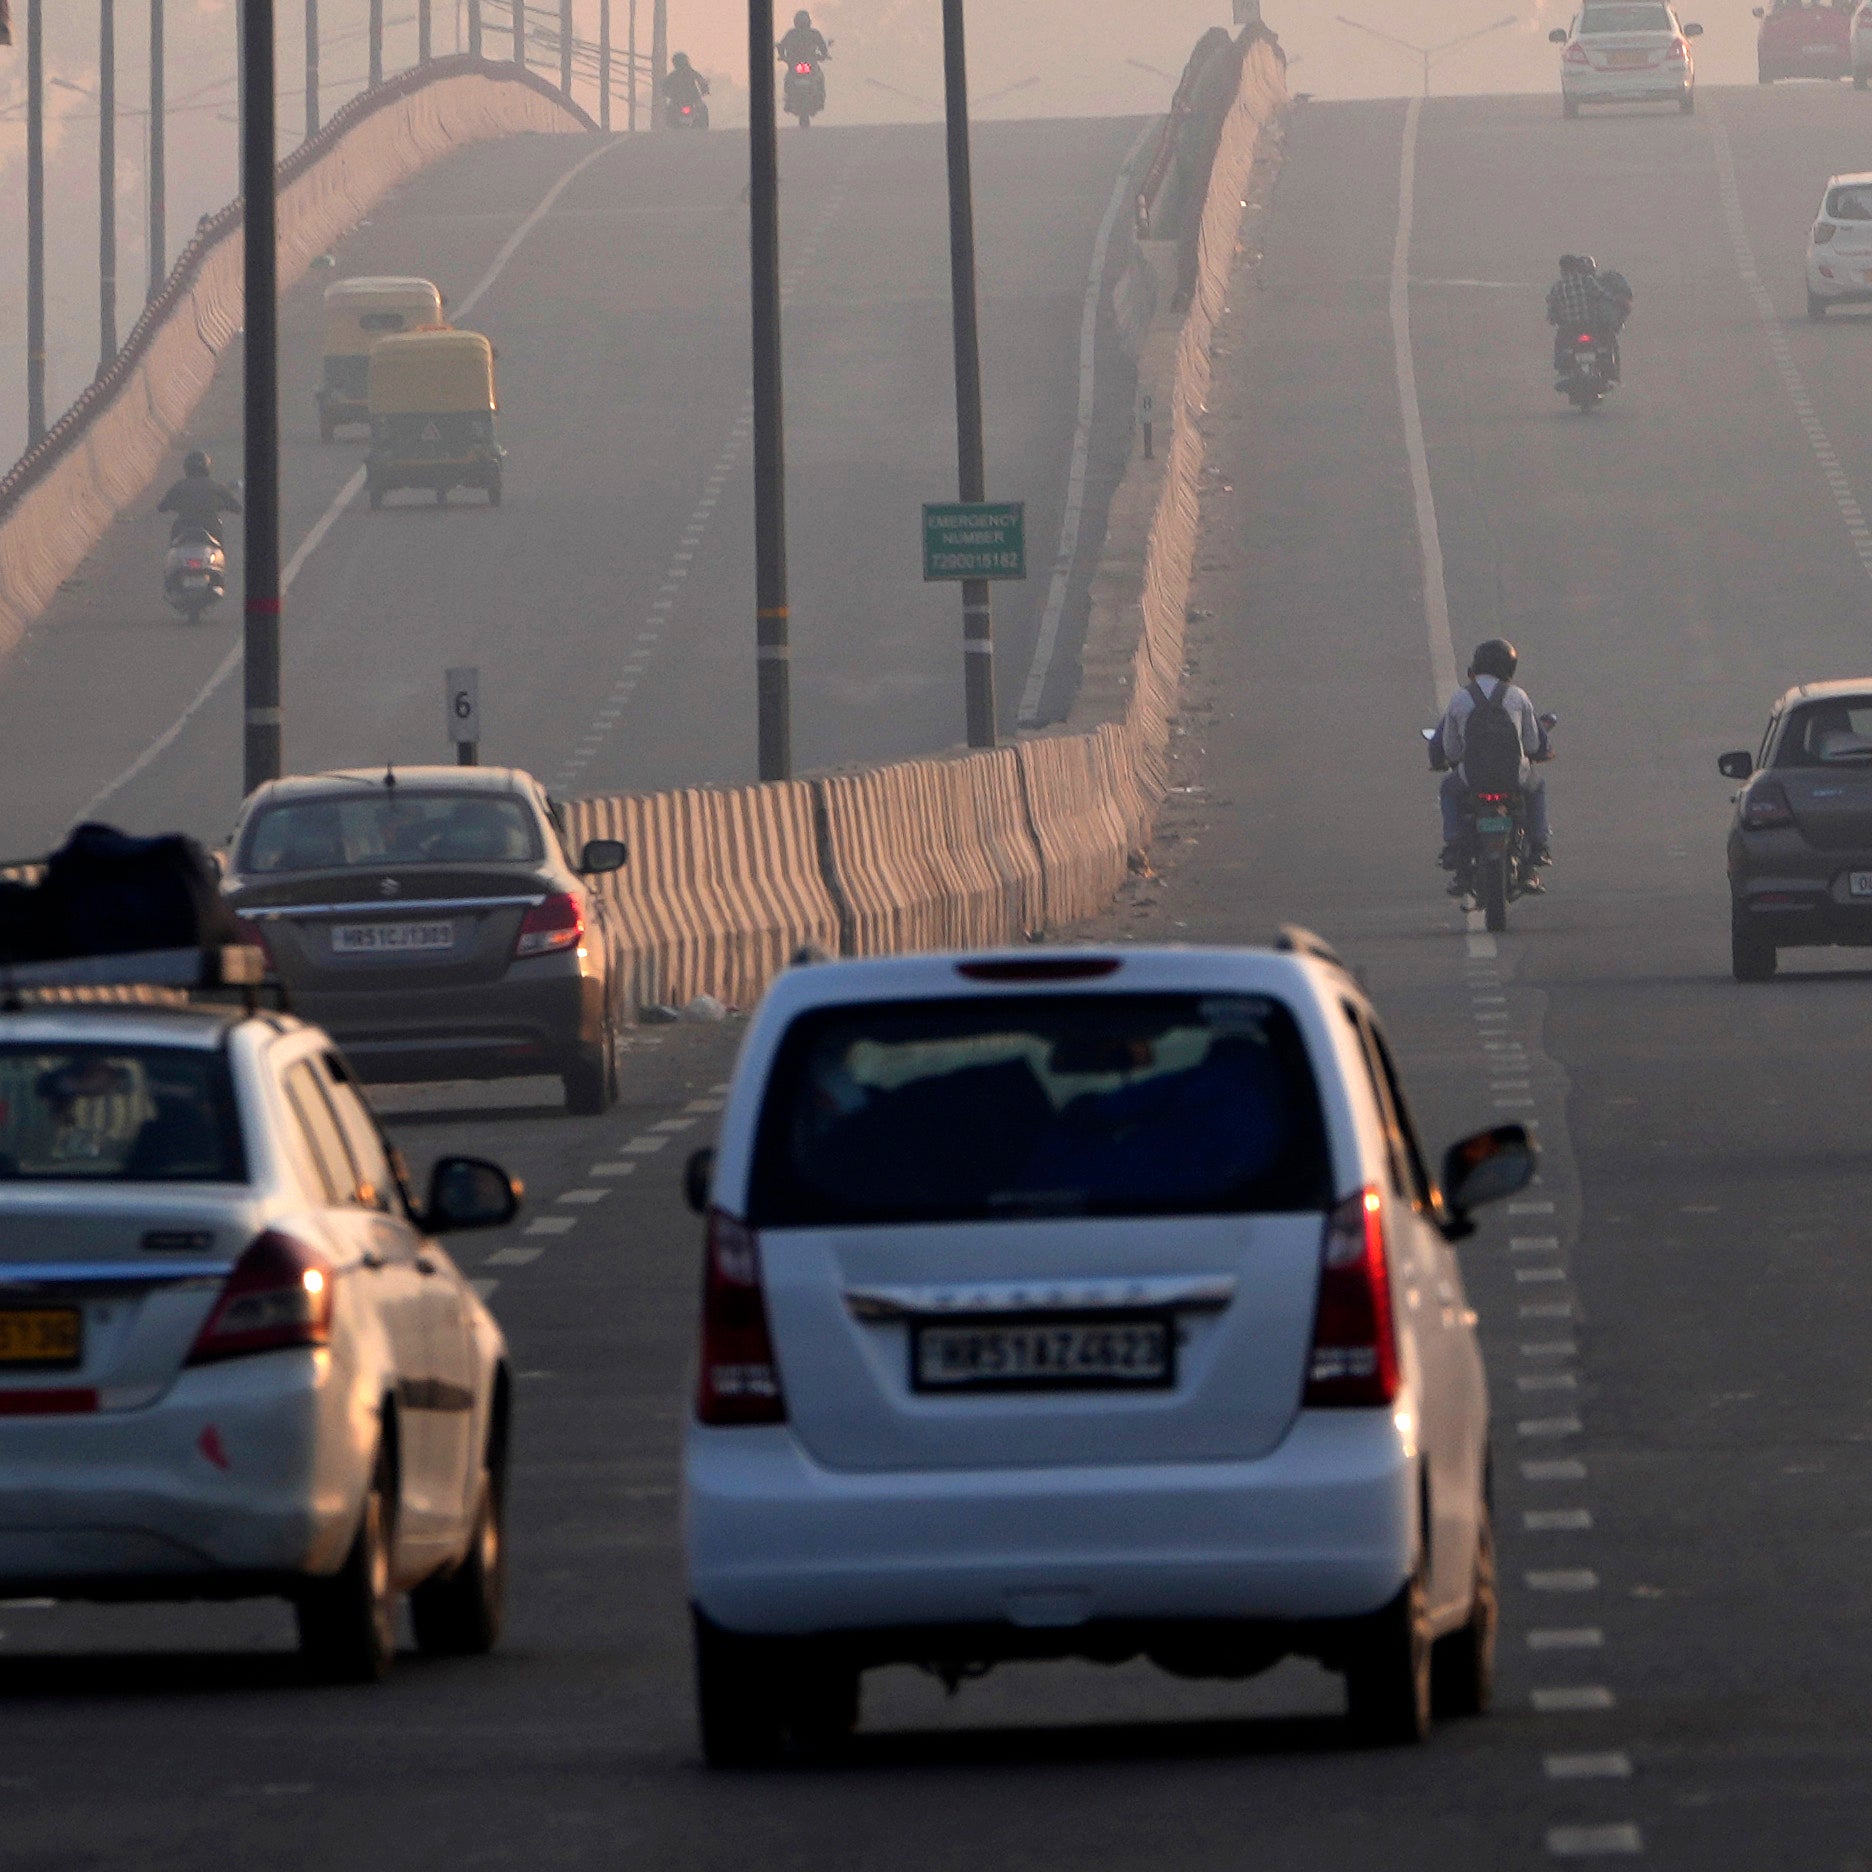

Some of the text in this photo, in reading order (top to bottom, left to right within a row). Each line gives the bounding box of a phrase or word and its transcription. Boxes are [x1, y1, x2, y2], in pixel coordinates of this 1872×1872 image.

[928, 514, 1019, 529] EMERGENCY
[942, 530, 1005, 545] NUMBER
[455, 691, 471, 718] 6
